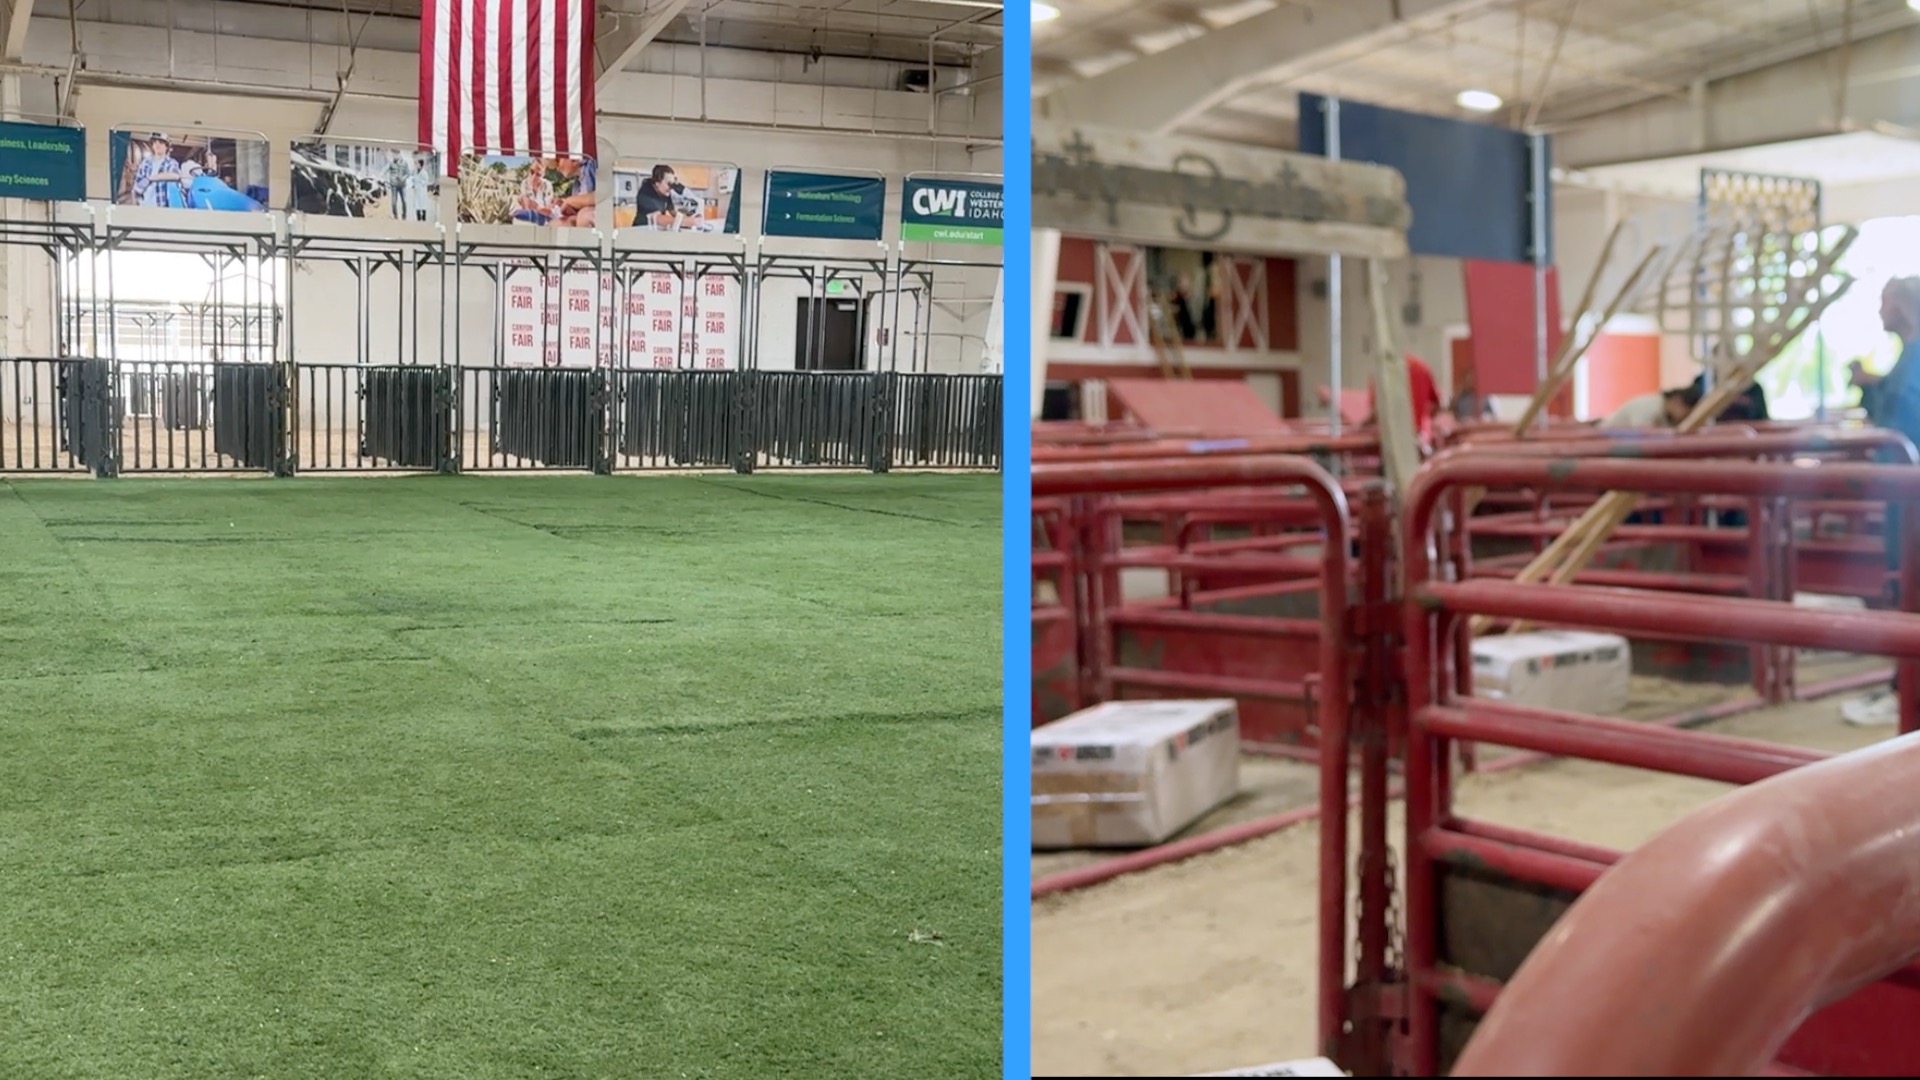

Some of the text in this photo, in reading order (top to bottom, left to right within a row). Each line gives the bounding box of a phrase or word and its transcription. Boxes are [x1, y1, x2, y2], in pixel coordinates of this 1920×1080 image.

[28, 140, 72, 154] Leadership,
[14, 174, 49, 186] Sciences
[970, 191, 1000, 199] COLLEGE
[912, 188, 966, 217] CWI
[796, 213, 855, 223] Fermentation Science
[511, 285, 533, 293] CANYON
[652, 281, 671, 295] FAIR
[705, 283, 725, 296] FAIR
[511, 295, 533, 309] FAIR
[569, 298, 590, 312] FAIR
[653, 310, 672, 318] CANYON
[706, 311, 725, 319] CANYON
[570, 326, 591, 334] CANYON
[653, 319, 672, 332] FAIR
[706, 321, 725, 334] FAIR
[512, 333, 534, 347] FAIR
[570, 336, 591, 349] FAIR
[653, 356, 673, 369] FAIR
[706, 357, 725, 369] FAIR
